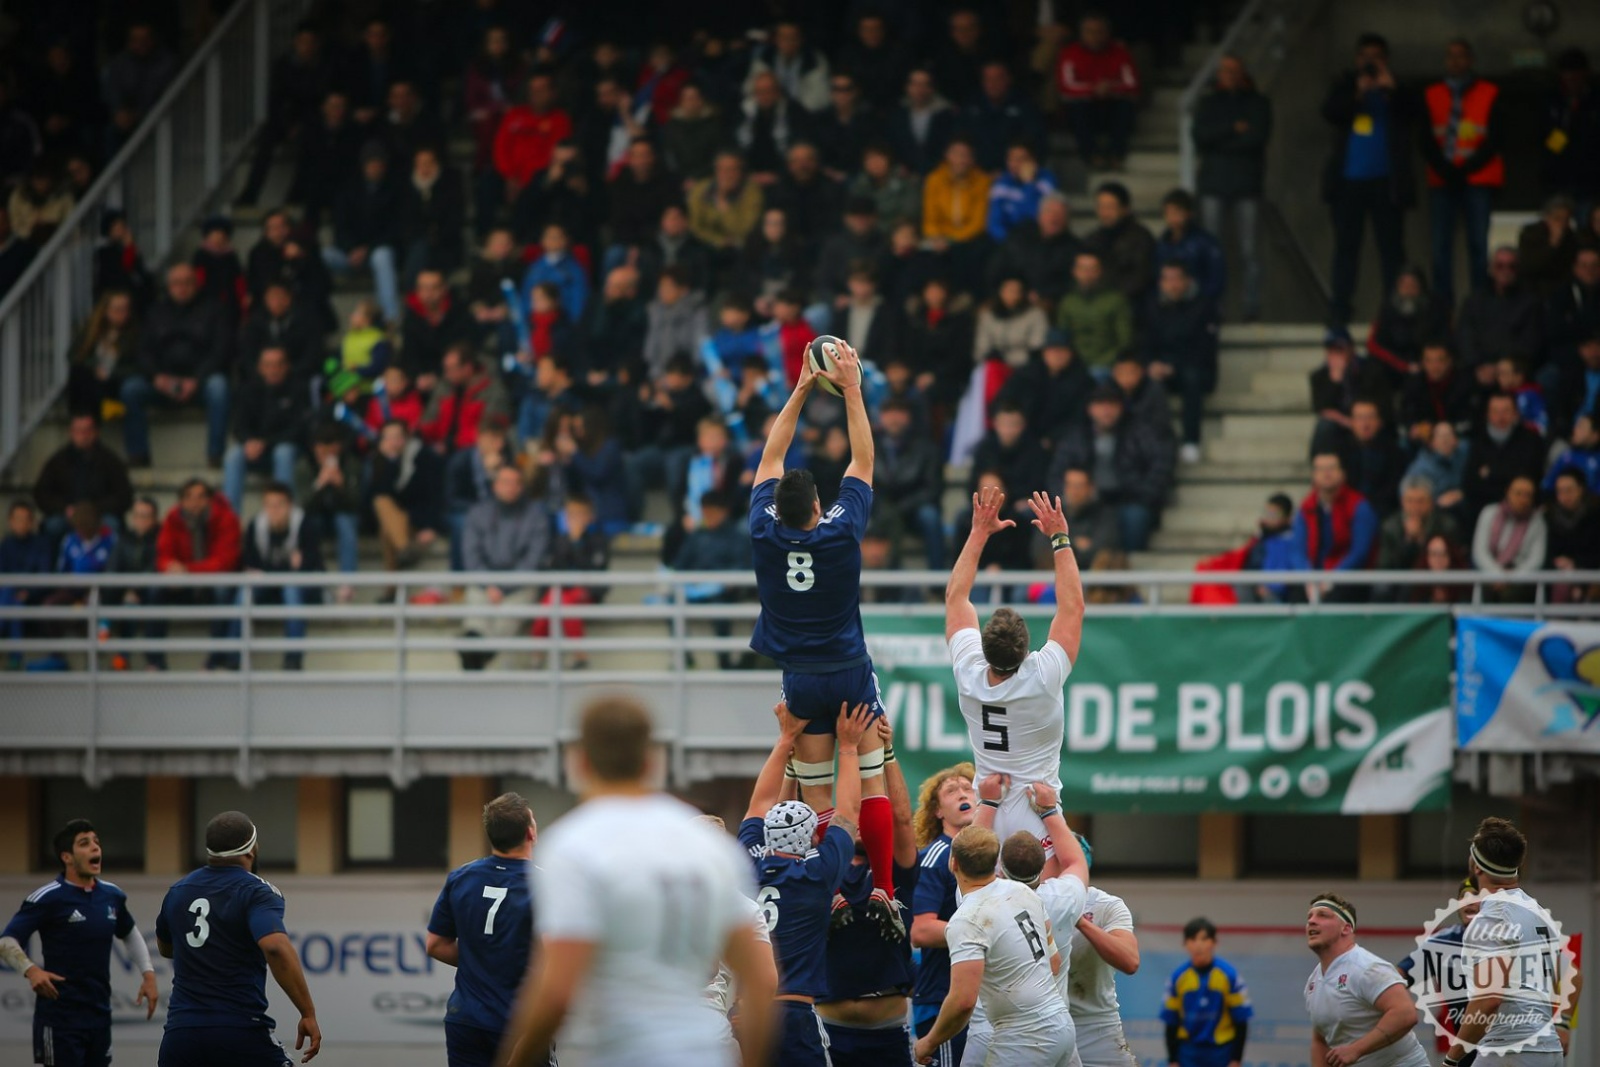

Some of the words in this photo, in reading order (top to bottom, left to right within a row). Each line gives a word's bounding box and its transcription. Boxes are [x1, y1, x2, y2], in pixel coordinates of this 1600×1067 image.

[786, 552, 815, 592] 8
[881, 684, 966, 752] VIL
[1069, 683, 1157, 751] DE
[1178, 682, 1375, 750] BLOIS
[981, 705, 1009, 752] 5
[186, 898, 210, 948] 3
[482, 886, 508, 935] 7
[757, 886, 781, 931] 6
[294, 933, 438, 977] OFELY
